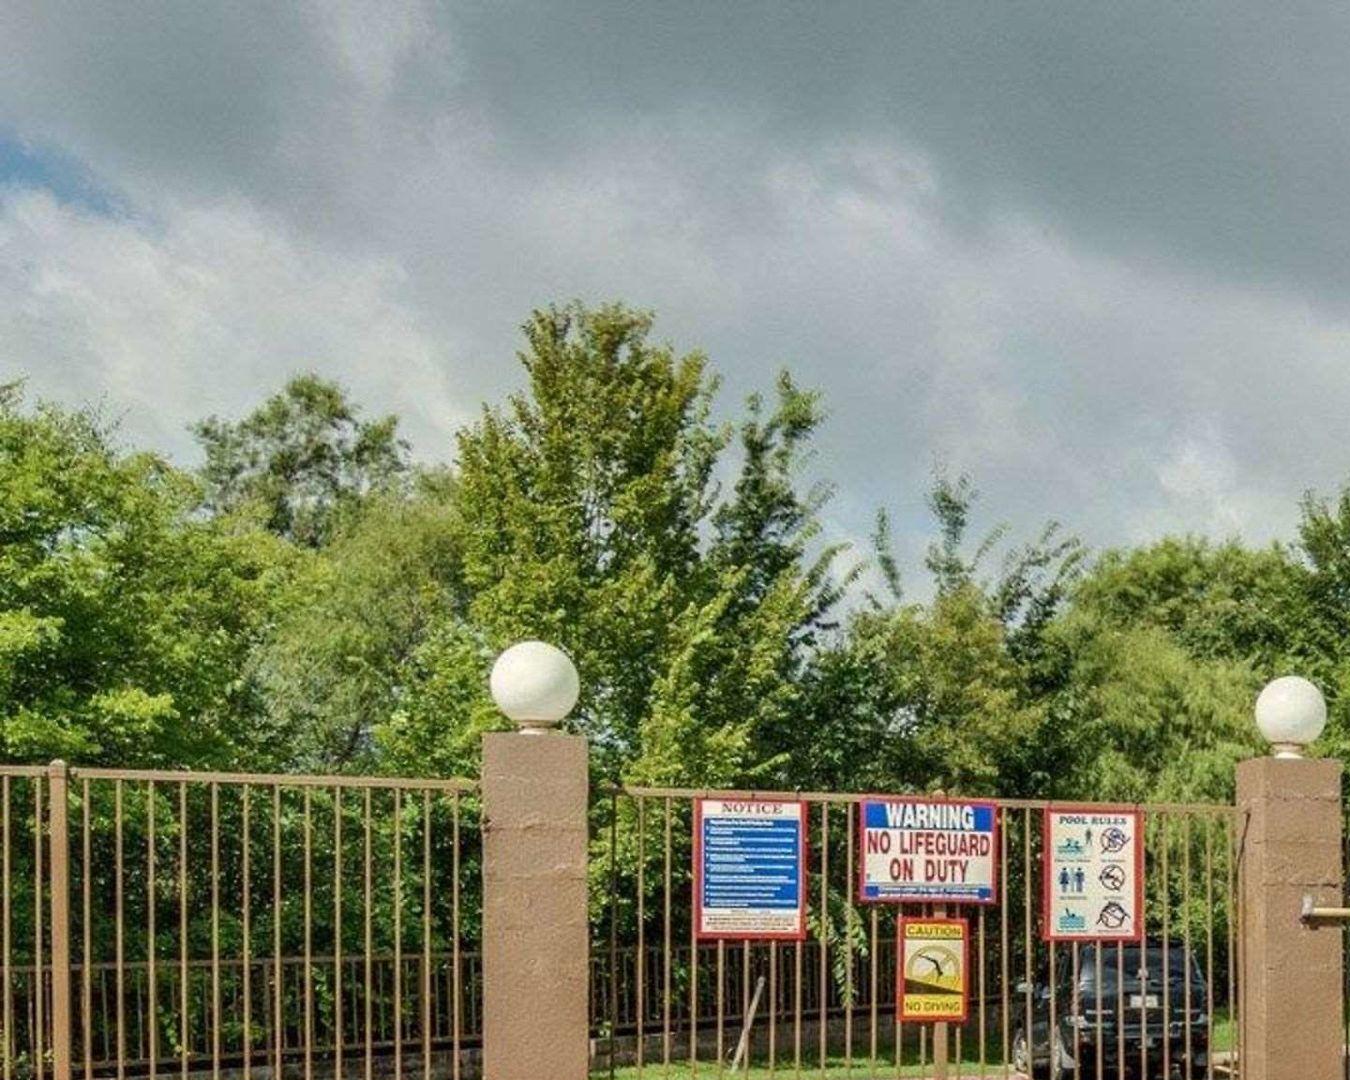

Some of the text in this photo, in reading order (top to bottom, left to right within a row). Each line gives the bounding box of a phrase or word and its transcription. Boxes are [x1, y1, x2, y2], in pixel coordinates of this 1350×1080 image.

[722, 803, 783, 815] NOTICE
[886, 803, 975, 830] WARNING
[1059, 816, 1088, 825] POOL
[868, 831, 990, 856] NO LIFEGUARD
[890, 859, 969, 882] ON DUTY
[907, 926, 961, 936] CAUTION
[906, 1002, 960, 1012] NO DIVING
